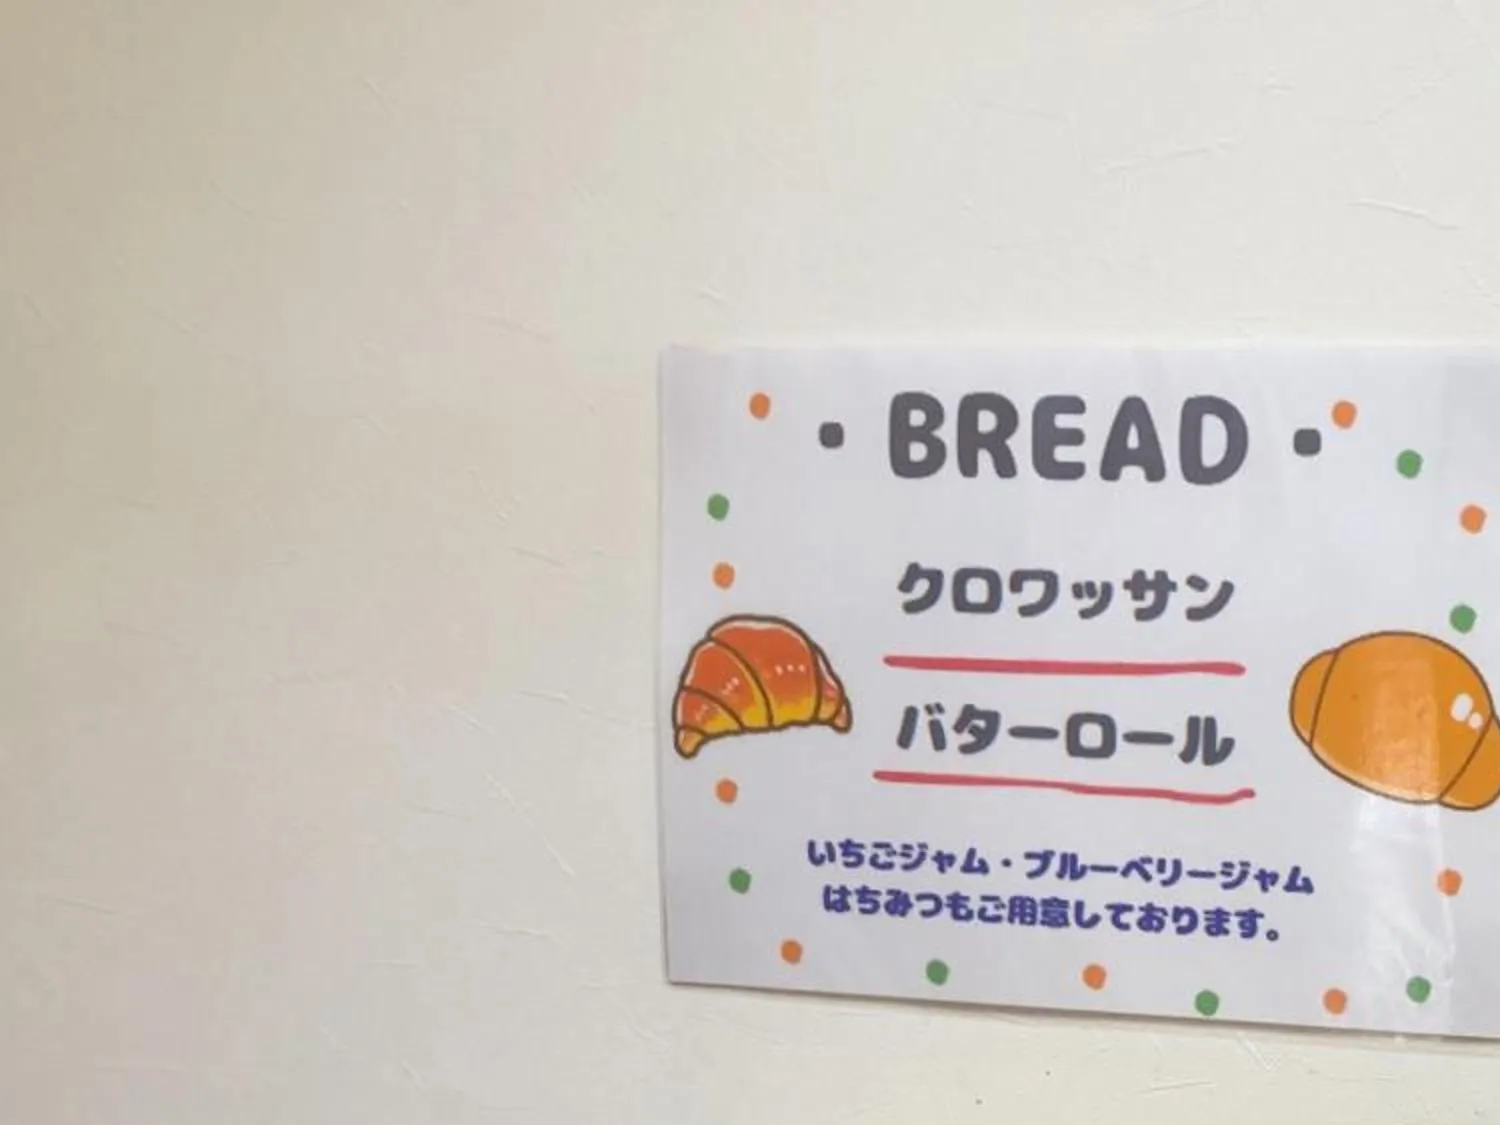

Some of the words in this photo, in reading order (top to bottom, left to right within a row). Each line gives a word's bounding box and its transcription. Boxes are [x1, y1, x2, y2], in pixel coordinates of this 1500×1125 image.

[887, 391, 1250, 486] BREAD
[896, 563, 1236, 622] クロワッサン
[897, 703, 1236, 768] バターロール
[806, 838, 1316, 897] いちごジャム・ブルーベリージャム
[822, 884, 1281, 943] はちみつもご用意しております。
